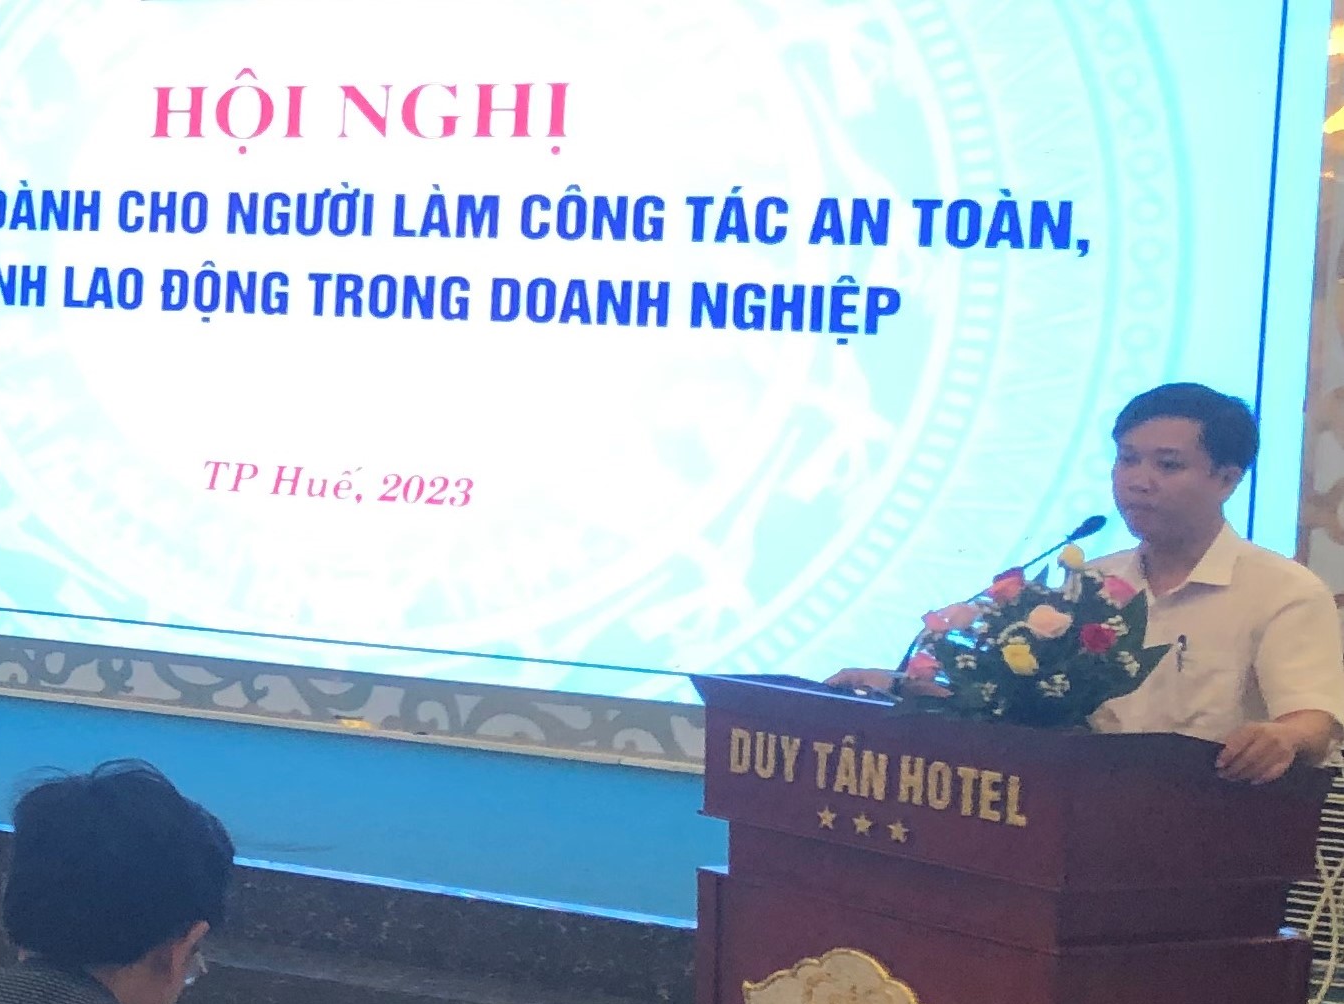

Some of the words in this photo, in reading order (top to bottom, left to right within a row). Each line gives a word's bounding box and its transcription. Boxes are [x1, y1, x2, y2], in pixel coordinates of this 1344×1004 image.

[152, 68, 305, 155] HỘI
[338, 82, 570, 155] NGHỊ
[118, 189, 209, 235] CHO
[226, 181, 374, 237] NGƯỜI
[393, 181, 500, 239] LÀM
[520, 184, 665, 243] CÔNG
[686, 186, 789, 245] TÁC
[807, 197, 890, 247] AN
[911, 188, 1090, 256] TOÀN,
[63, 266, 144, 311] LAO
[160, 261, 289, 323] ĐỘNG
[308, 272, 470, 321] TRONG
[489, 277, 670, 328] DOANH
[690, 275, 901, 345] NGHIỆP
[204, 461, 259, 492] TP
[269, 466, 365, 503] Huế,
[377, 474, 475, 507] 2023
[729, 728, 800, 782] DUY
[813, 735, 887, 801] TÂN
[898, 754, 1028, 828] HOTEL
